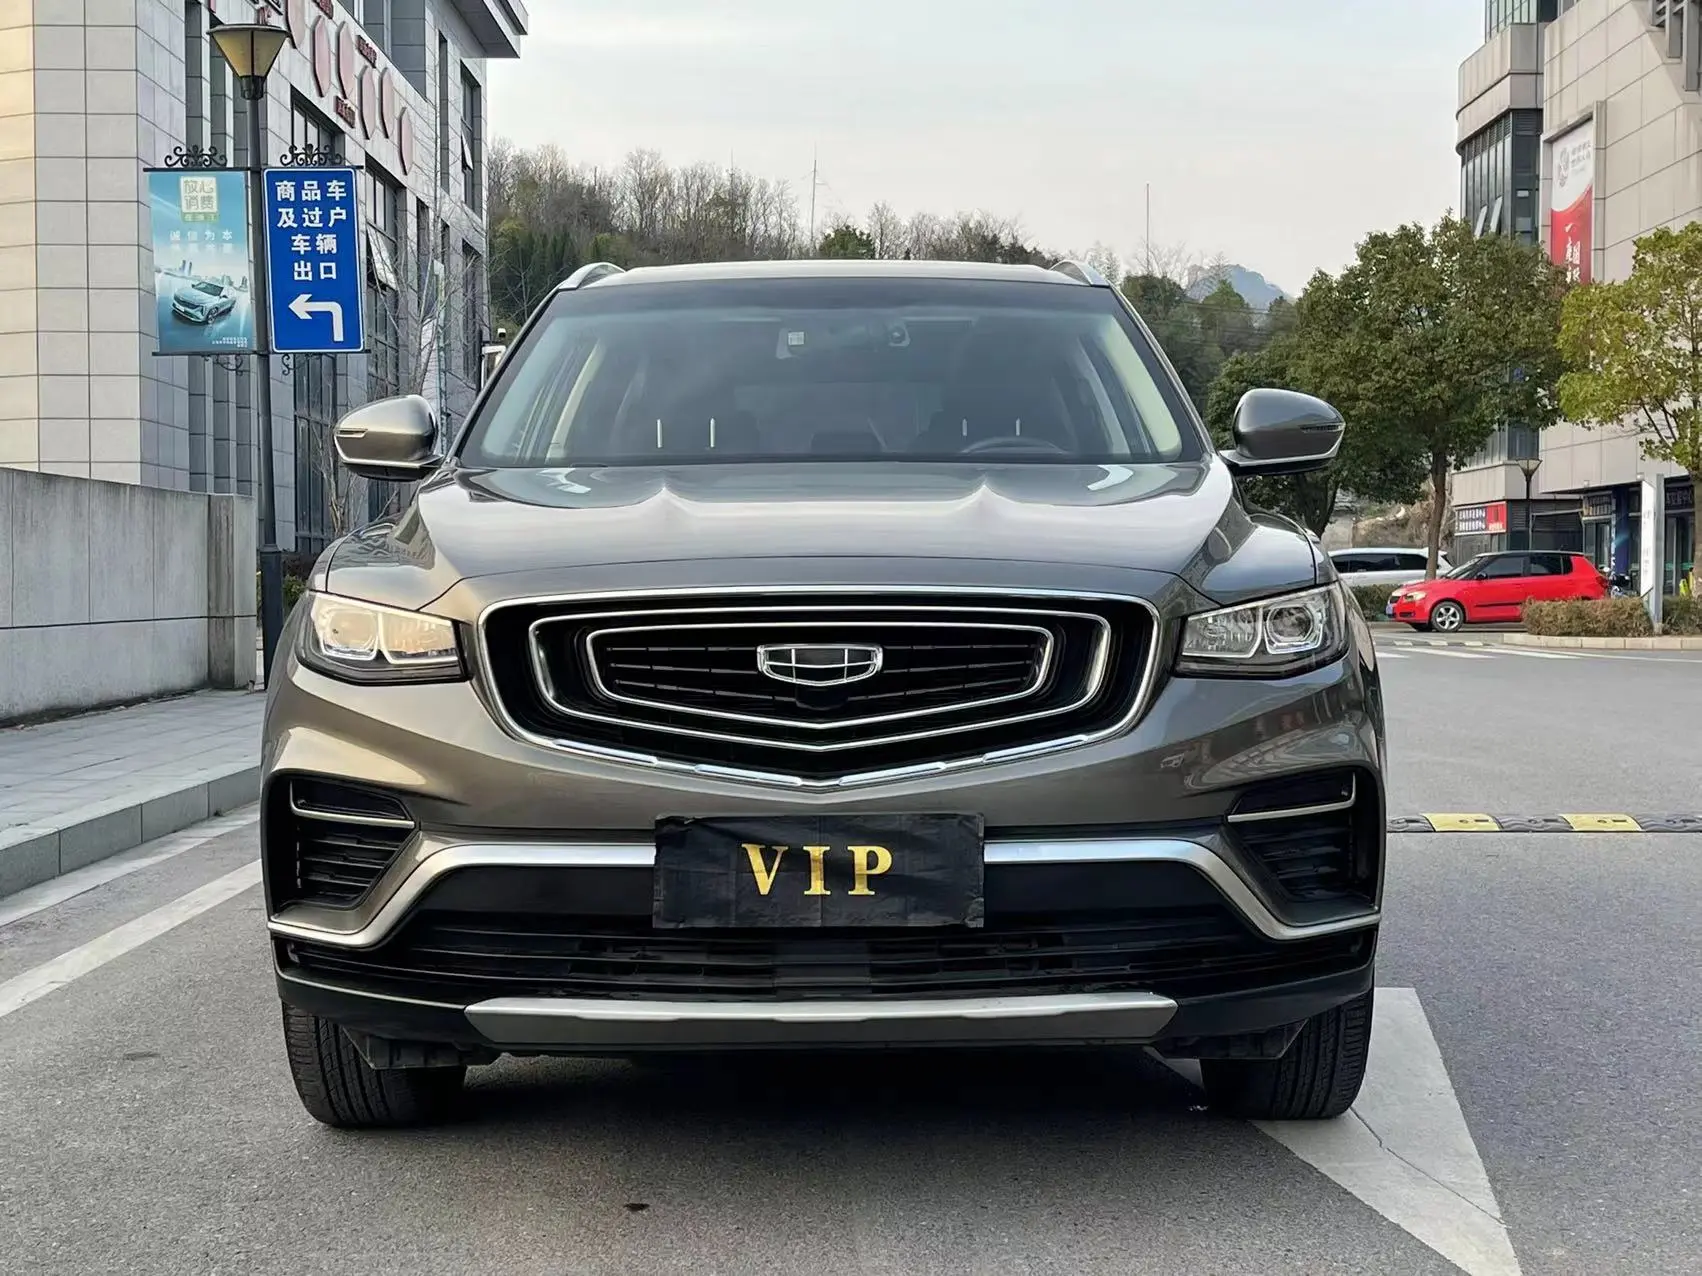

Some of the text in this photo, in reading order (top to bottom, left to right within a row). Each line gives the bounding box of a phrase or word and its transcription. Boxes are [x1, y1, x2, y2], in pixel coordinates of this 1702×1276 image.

[184, 179, 214, 194] 放心
[275, 180, 347, 202] 商品车
[185, 195, 214, 210] 消费
[277, 207, 347, 228] 及过户
[291, 233, 337, 255] 车辆
[294, 261, 337, 282] 出口
[741, 843, 893, 896] VIP
